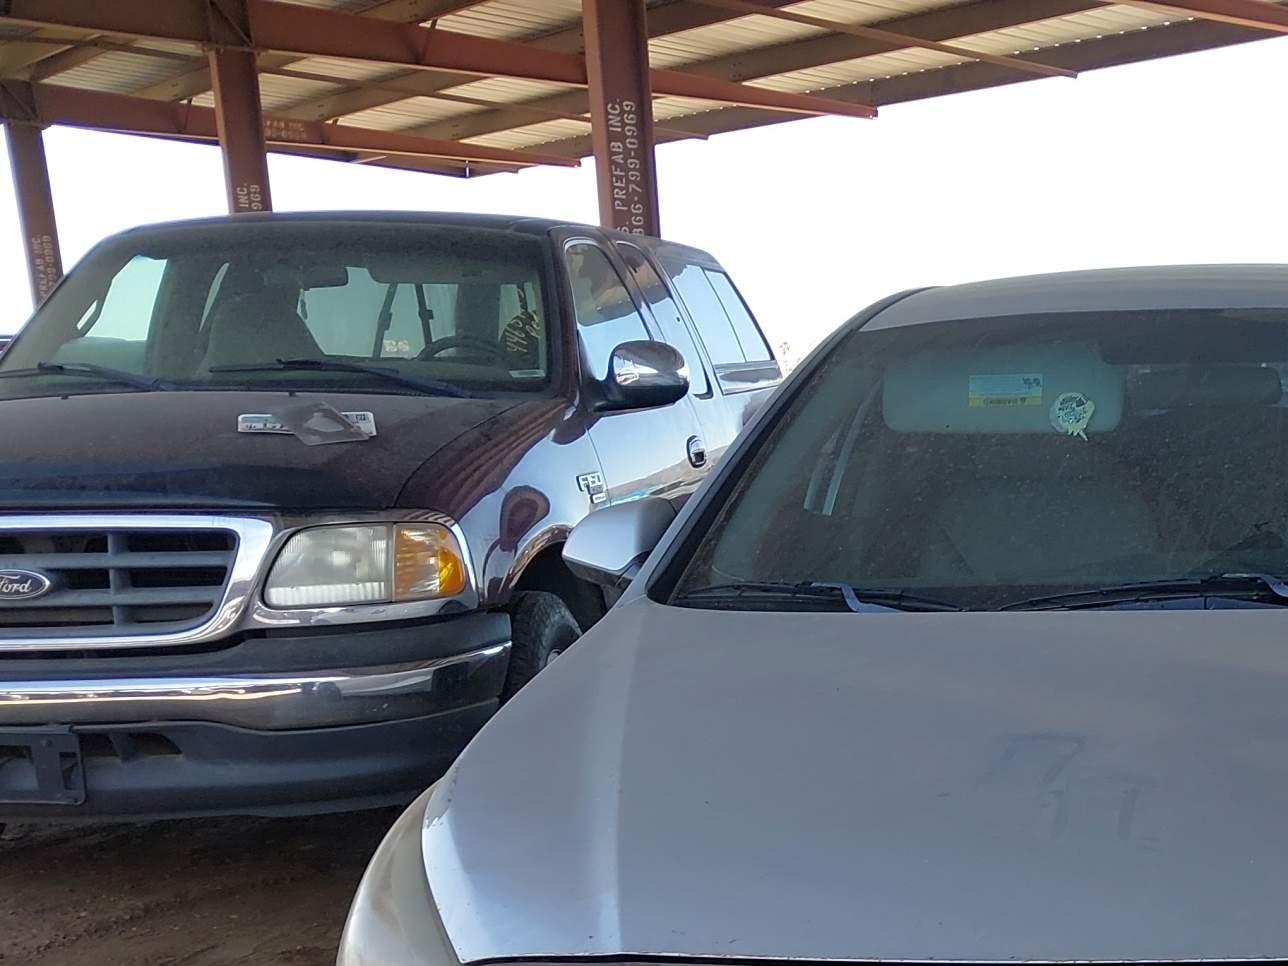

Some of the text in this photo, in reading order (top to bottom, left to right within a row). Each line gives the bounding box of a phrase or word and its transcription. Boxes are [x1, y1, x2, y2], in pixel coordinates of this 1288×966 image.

[607, 98, 622, 131] INC.
[610, 142, 628, 210] PREFAB
[236, 183, 249, 208] INC.
